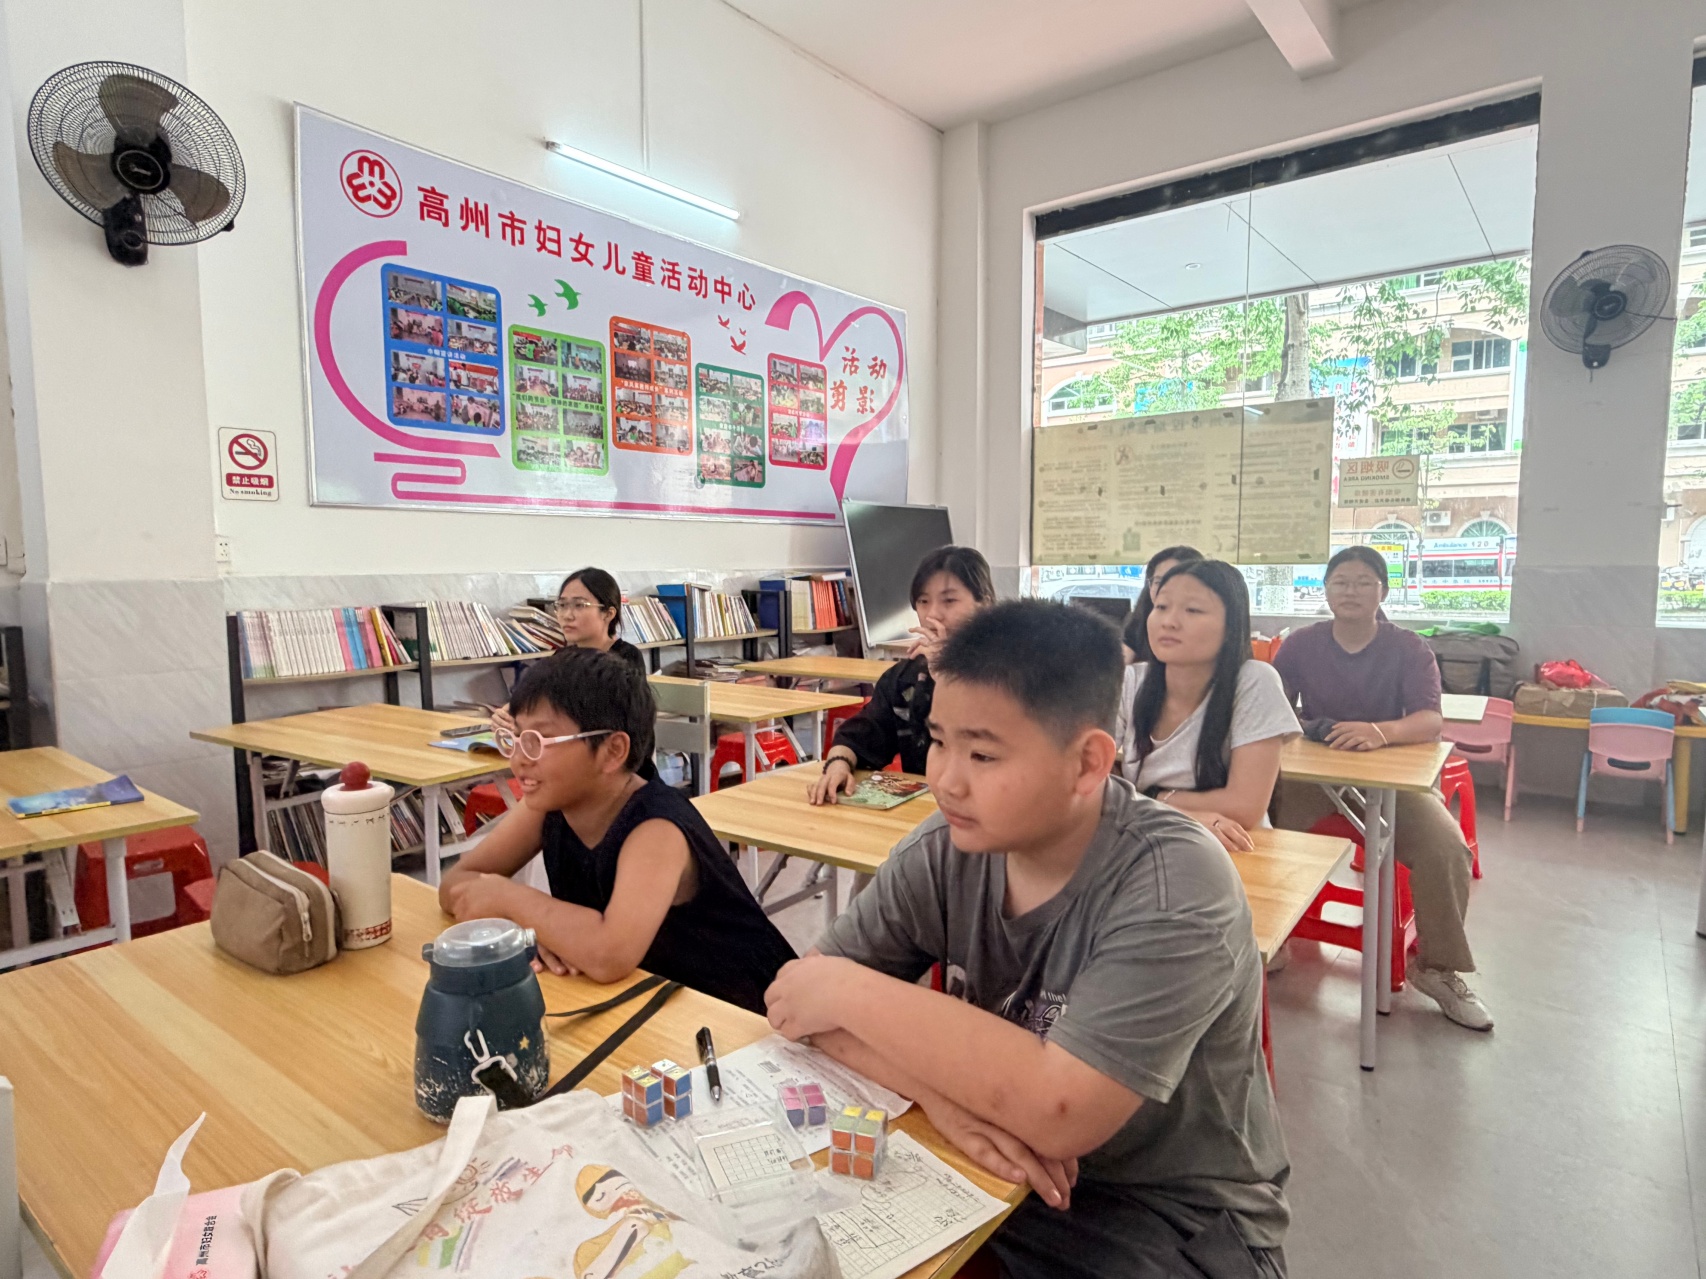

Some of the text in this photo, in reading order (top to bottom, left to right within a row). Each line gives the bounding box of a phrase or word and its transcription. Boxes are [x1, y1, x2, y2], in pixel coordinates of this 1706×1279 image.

[417, 186, 756, 312] 高州市妇女儿童活动中心
[841, 345, 888, 381] 活动
[829, 378, 876, 415] 剪影
[232, 476, 269, 486] 禁止吸烟
